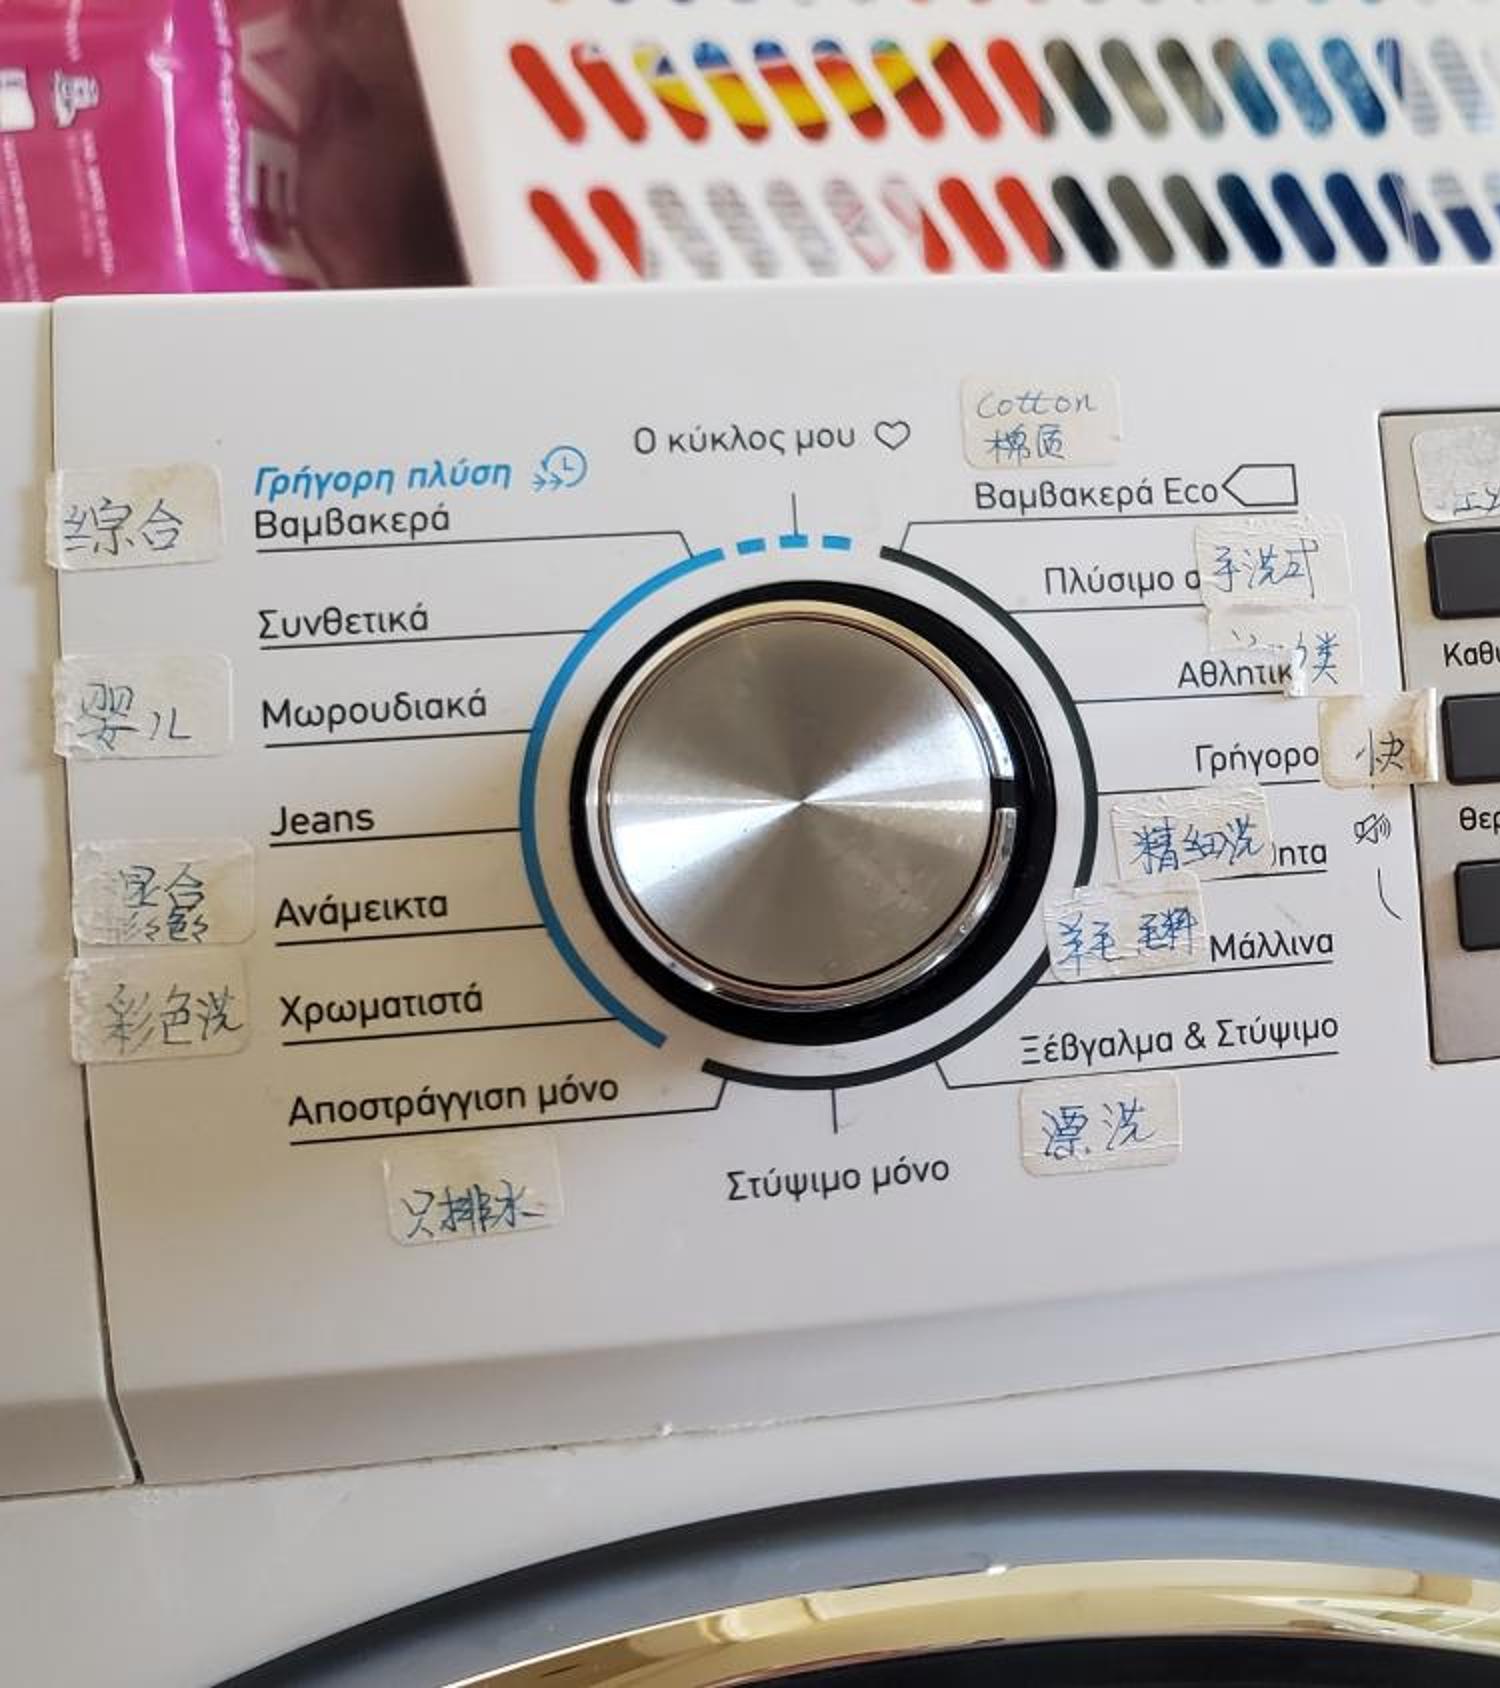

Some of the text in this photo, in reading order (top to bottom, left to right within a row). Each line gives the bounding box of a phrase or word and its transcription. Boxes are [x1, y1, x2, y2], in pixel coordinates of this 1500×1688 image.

[977, 390, 1097, 418] Cotton
[669, 422, 785, 456] κύκλος
[797, 426, 855, 456] μου
[256, 457, 512, 501] Γρήγορη πλύση
[976, 478, 1218, 515] Βαμβακερά Eco
[256, 503, 450, 544] Βαμβακερά
[1046, 565, 1174, 598] Πλύσιμο
[260, 603, 429, 639] Συνθετικά
[1178, 660, 1293, 689] Αθλητικ
[263, 688, 486, 731] Μωρουδιακά
[1196, 742, 1318, 776] Γρήγορο
[1356, 729, 1404, 777] 快
[271, 804, 375, 837] Jeans
[275, 894, 448, 931] Ανάμεικτα
[1210, 929, 1333, 962] Μάλλινα
[281, 982, 482, 1032] Χρωματιστά
[1020, 1014, 1339, 1067] Ξέβγαλμα & Στύψιμο
[289, 1074, 619, 1128] Αποστράγγιση μόνο
[727, 1157, 950, 1202] Στύψιμο μόνο
